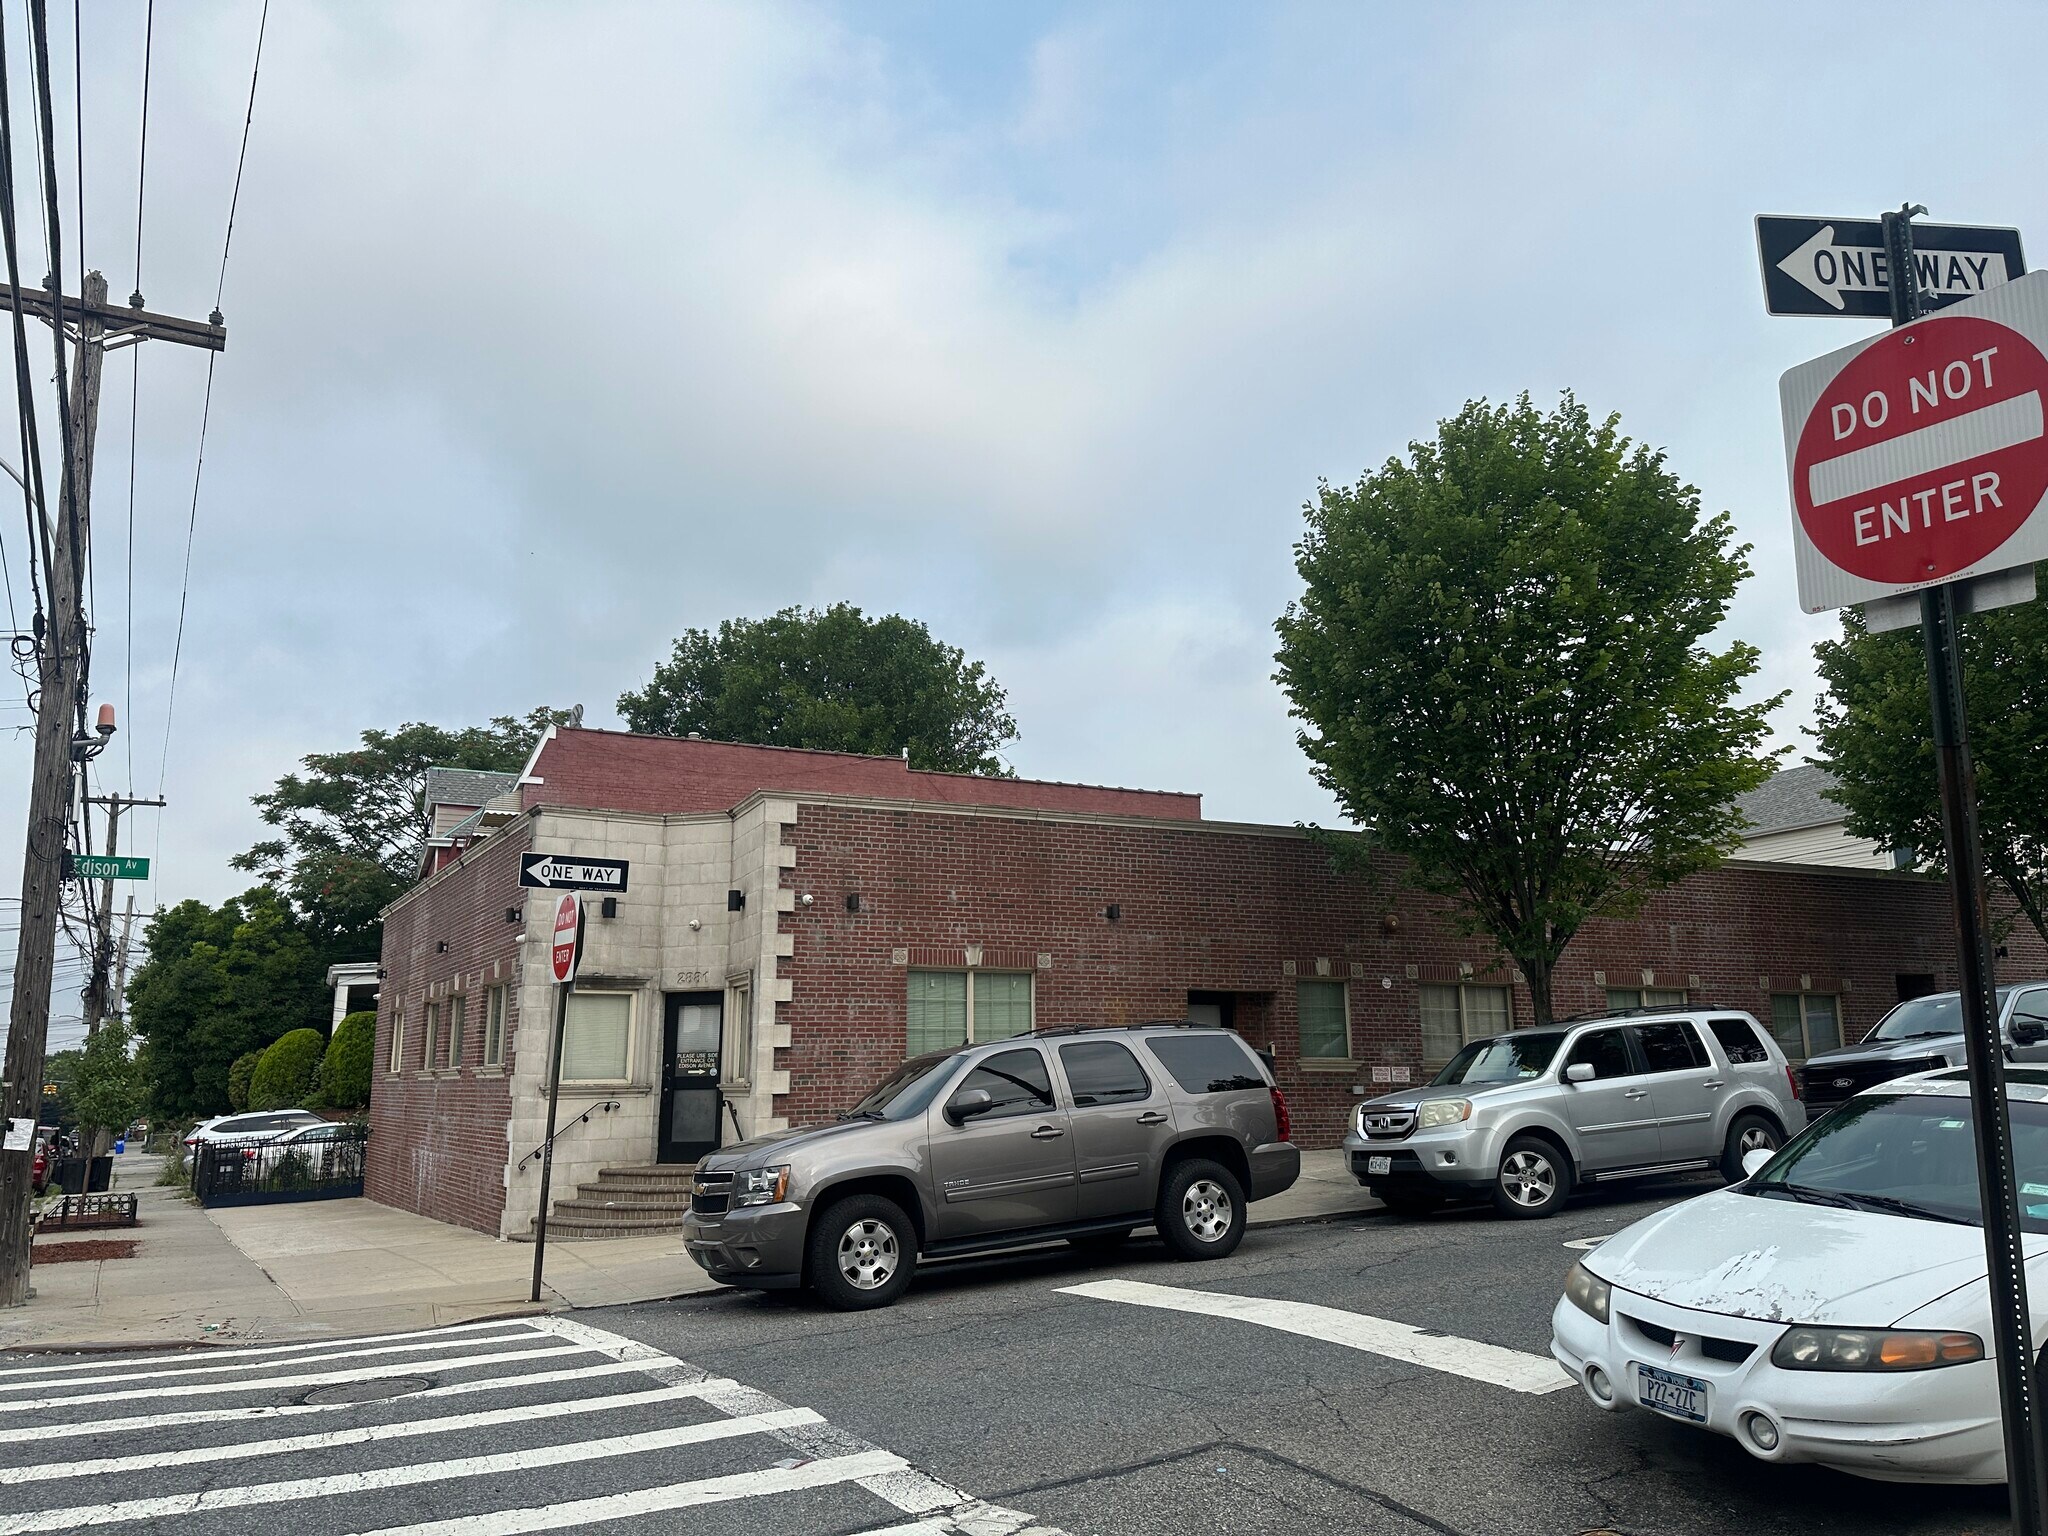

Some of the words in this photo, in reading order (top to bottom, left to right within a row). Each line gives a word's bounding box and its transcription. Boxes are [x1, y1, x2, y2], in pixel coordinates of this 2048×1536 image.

[1814, 249, 1889, 287] ONE
[1913, 254, 1989, 291] WAY
[1831, 390, 1889, 441] DO
[1908, 346, 1998, 414] NOT
[1853, 471, 2004, 547] ENTER
[1922, 571, 1974, 587] TRANSPORTATION
[72, 858, 119, 876] Edison
[125, 859, 138, 869] Av
[541, 864, 574, 879] ONE
[582, 867, 615, 882] WAY
[558, 913, 565, 926] DO
[565, 910, 574, 924] NOT
[555, 949, 570, 964] ENTER
[677, 971, 709, 983] 2881
[944, 1179, 969, 1187] TAHOE
[1653, 1371, 1669, 1382] NEW
